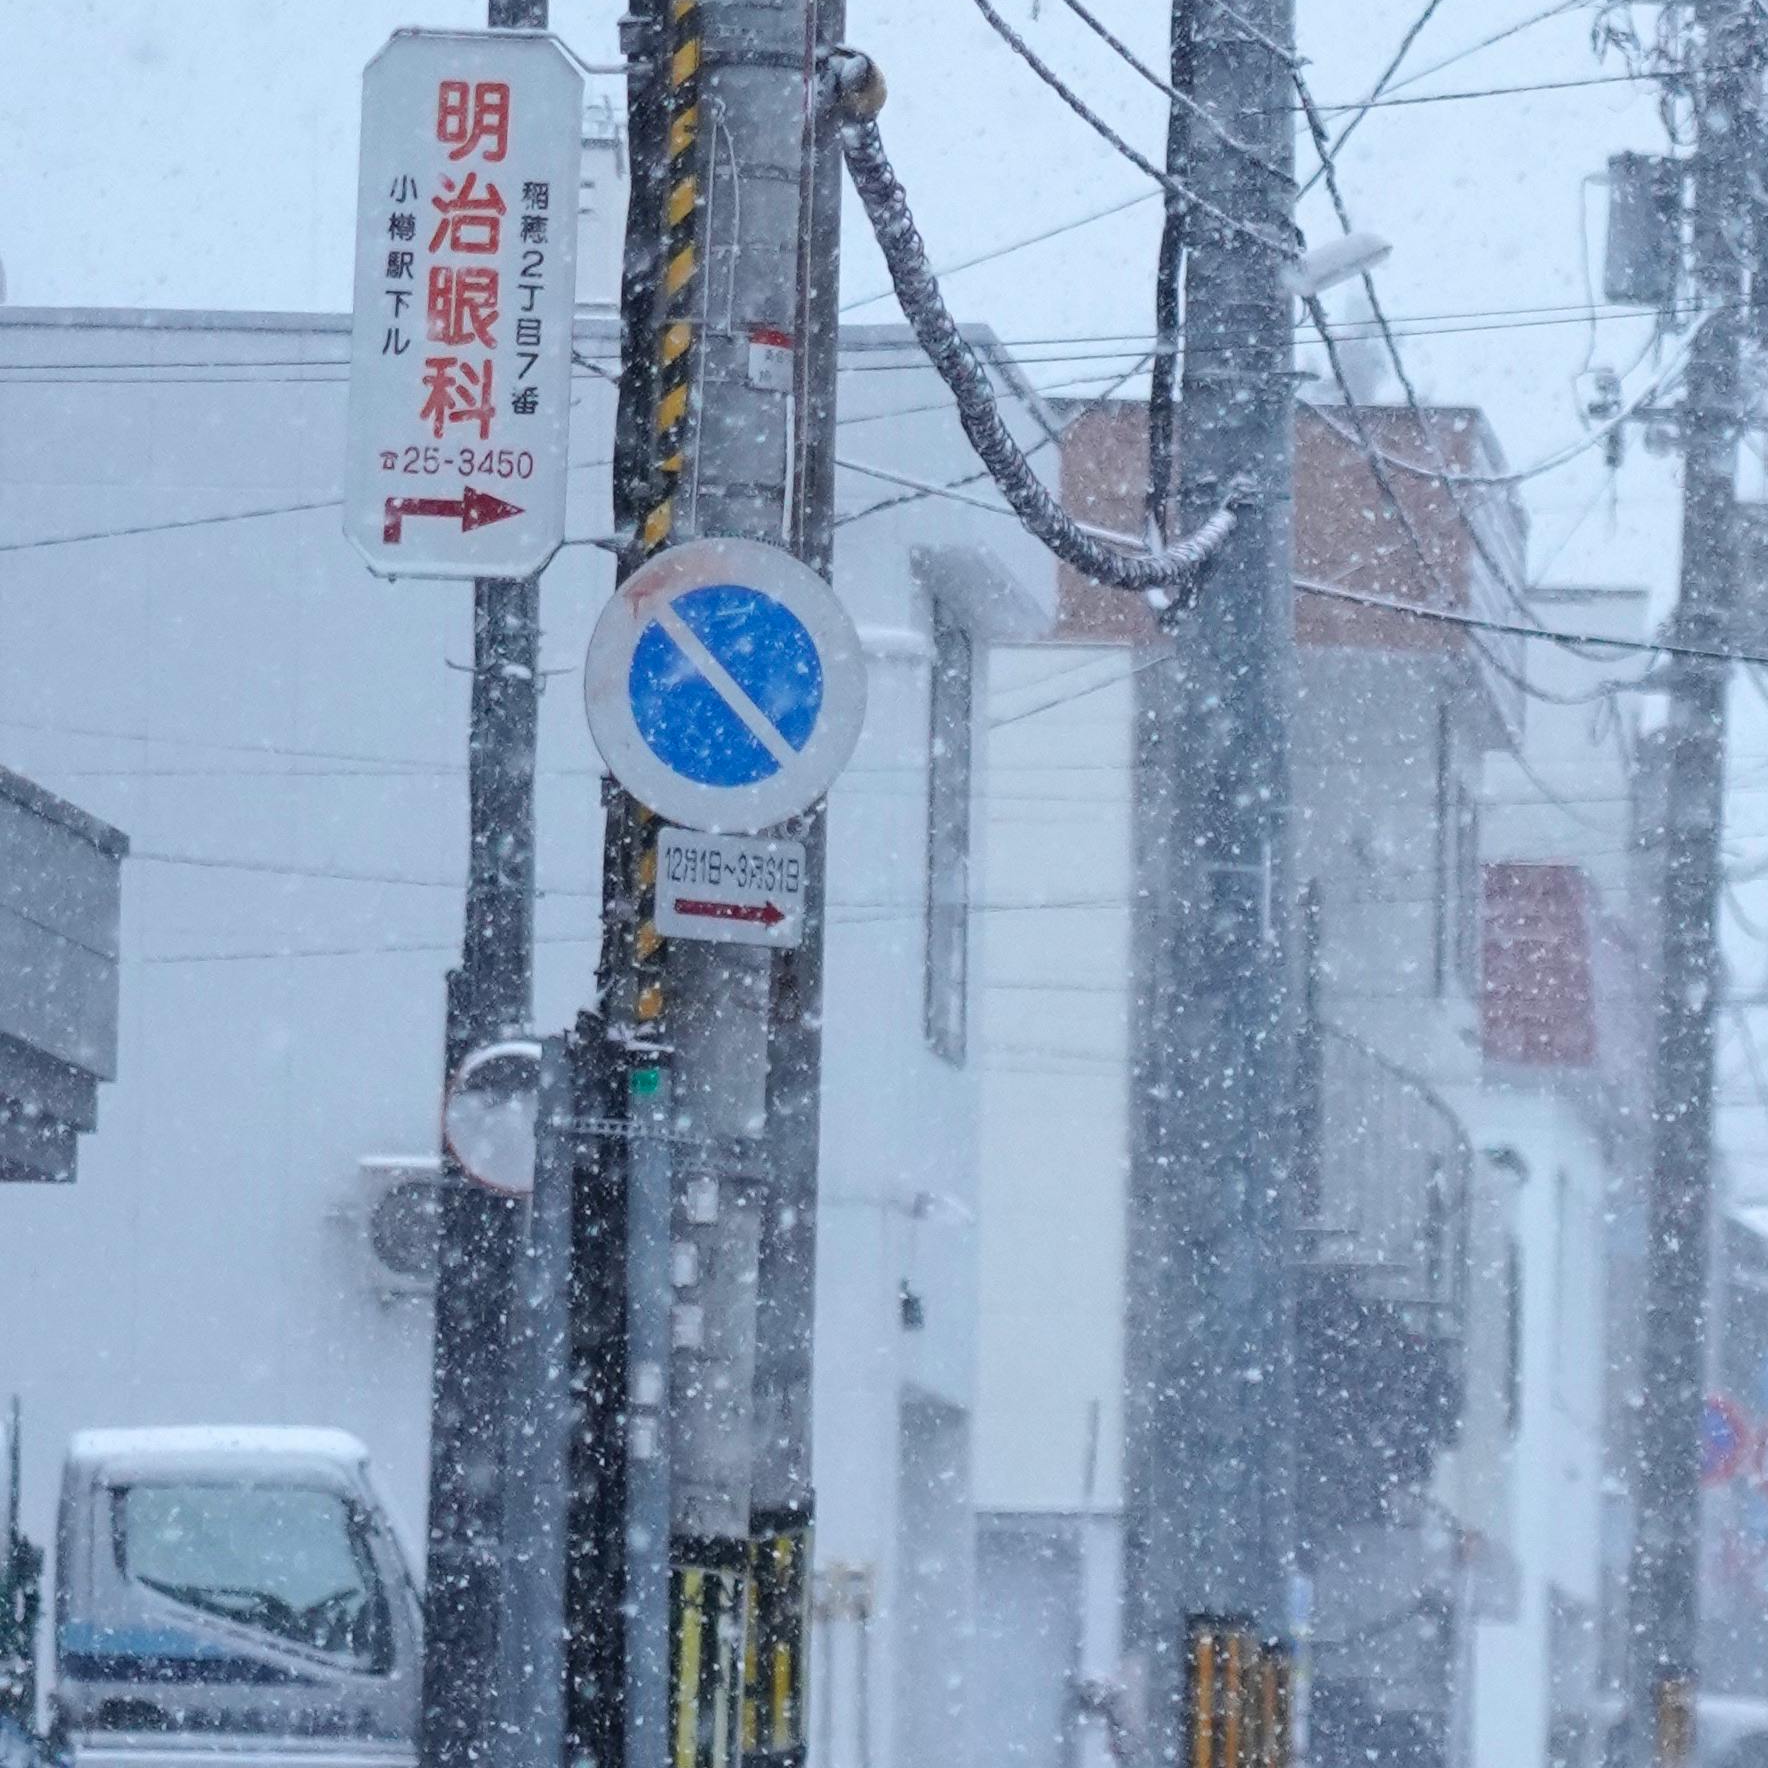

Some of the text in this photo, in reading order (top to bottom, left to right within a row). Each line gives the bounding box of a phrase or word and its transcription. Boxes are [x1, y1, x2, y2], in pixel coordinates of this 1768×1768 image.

[382, 174, 417, 356] 小樽駅下ル
[420, 80, 511, 441] 明治眼科
[511, 180, 550, 416] 稲穂2丁目7番
[402, 445, 534, 480] 25-3450
